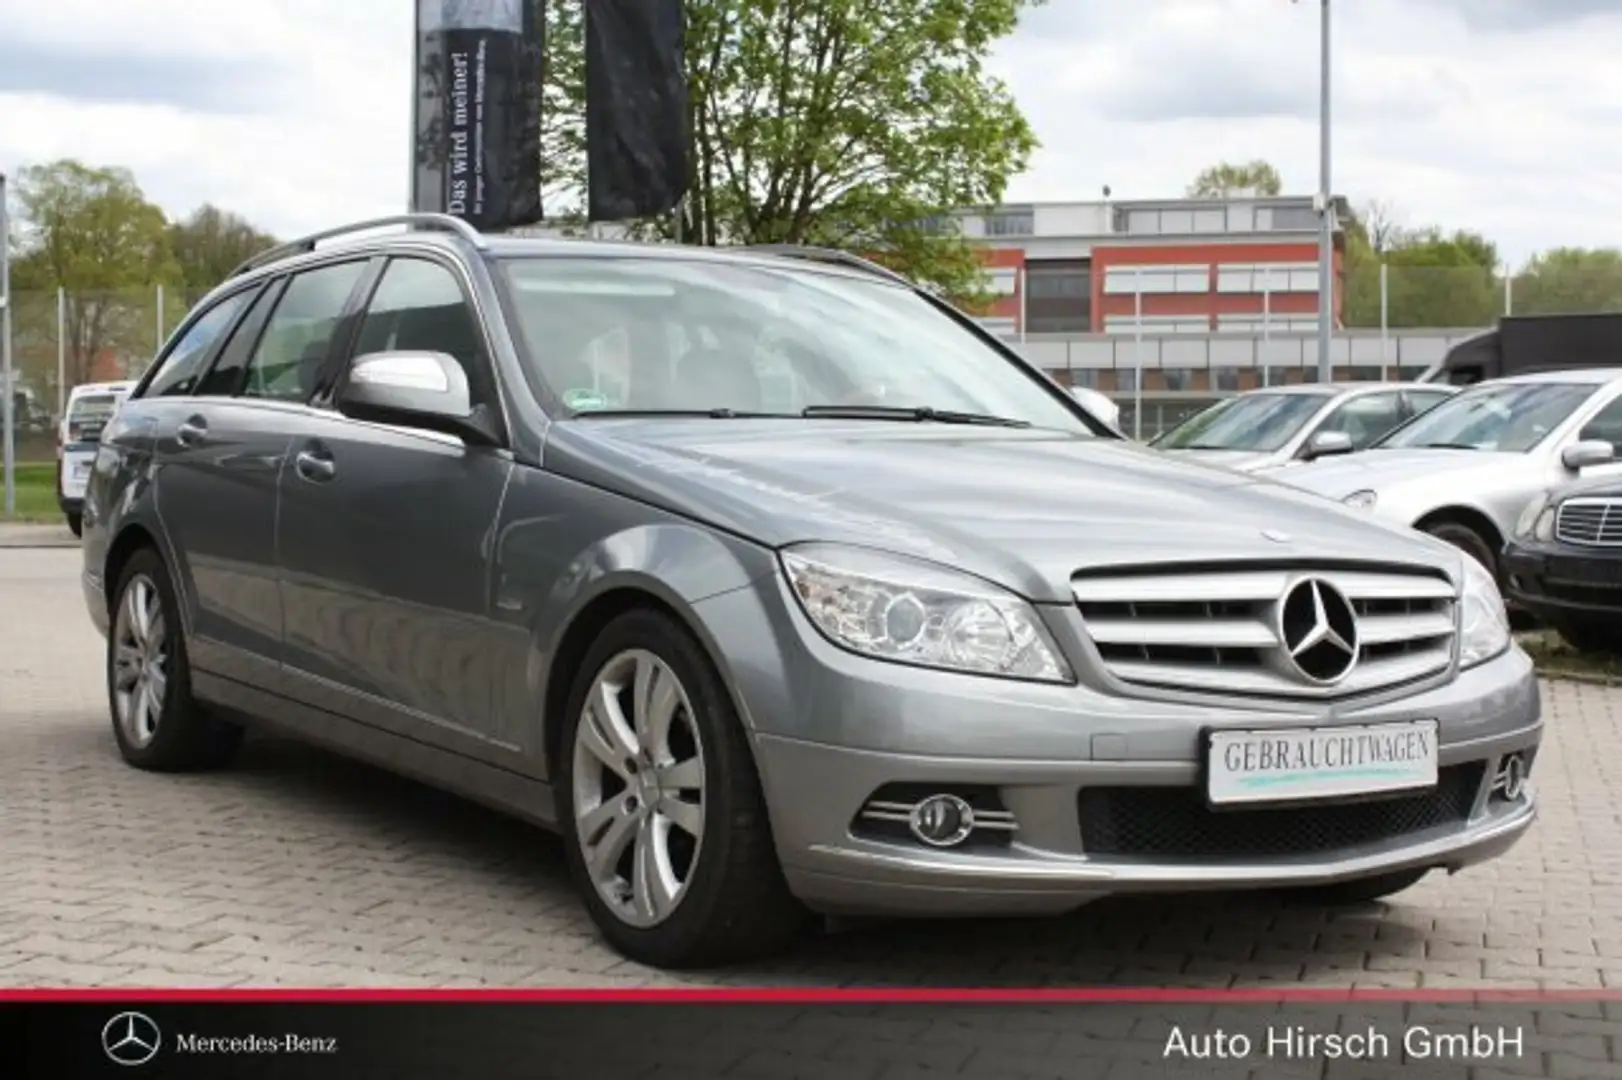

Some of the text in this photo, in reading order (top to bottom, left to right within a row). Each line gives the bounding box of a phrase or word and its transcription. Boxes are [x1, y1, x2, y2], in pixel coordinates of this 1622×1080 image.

[449, 52, 469, 215] Das wird meiner!
[1224, 731, 1429, 772] GEBRAUCHTWAGEN
